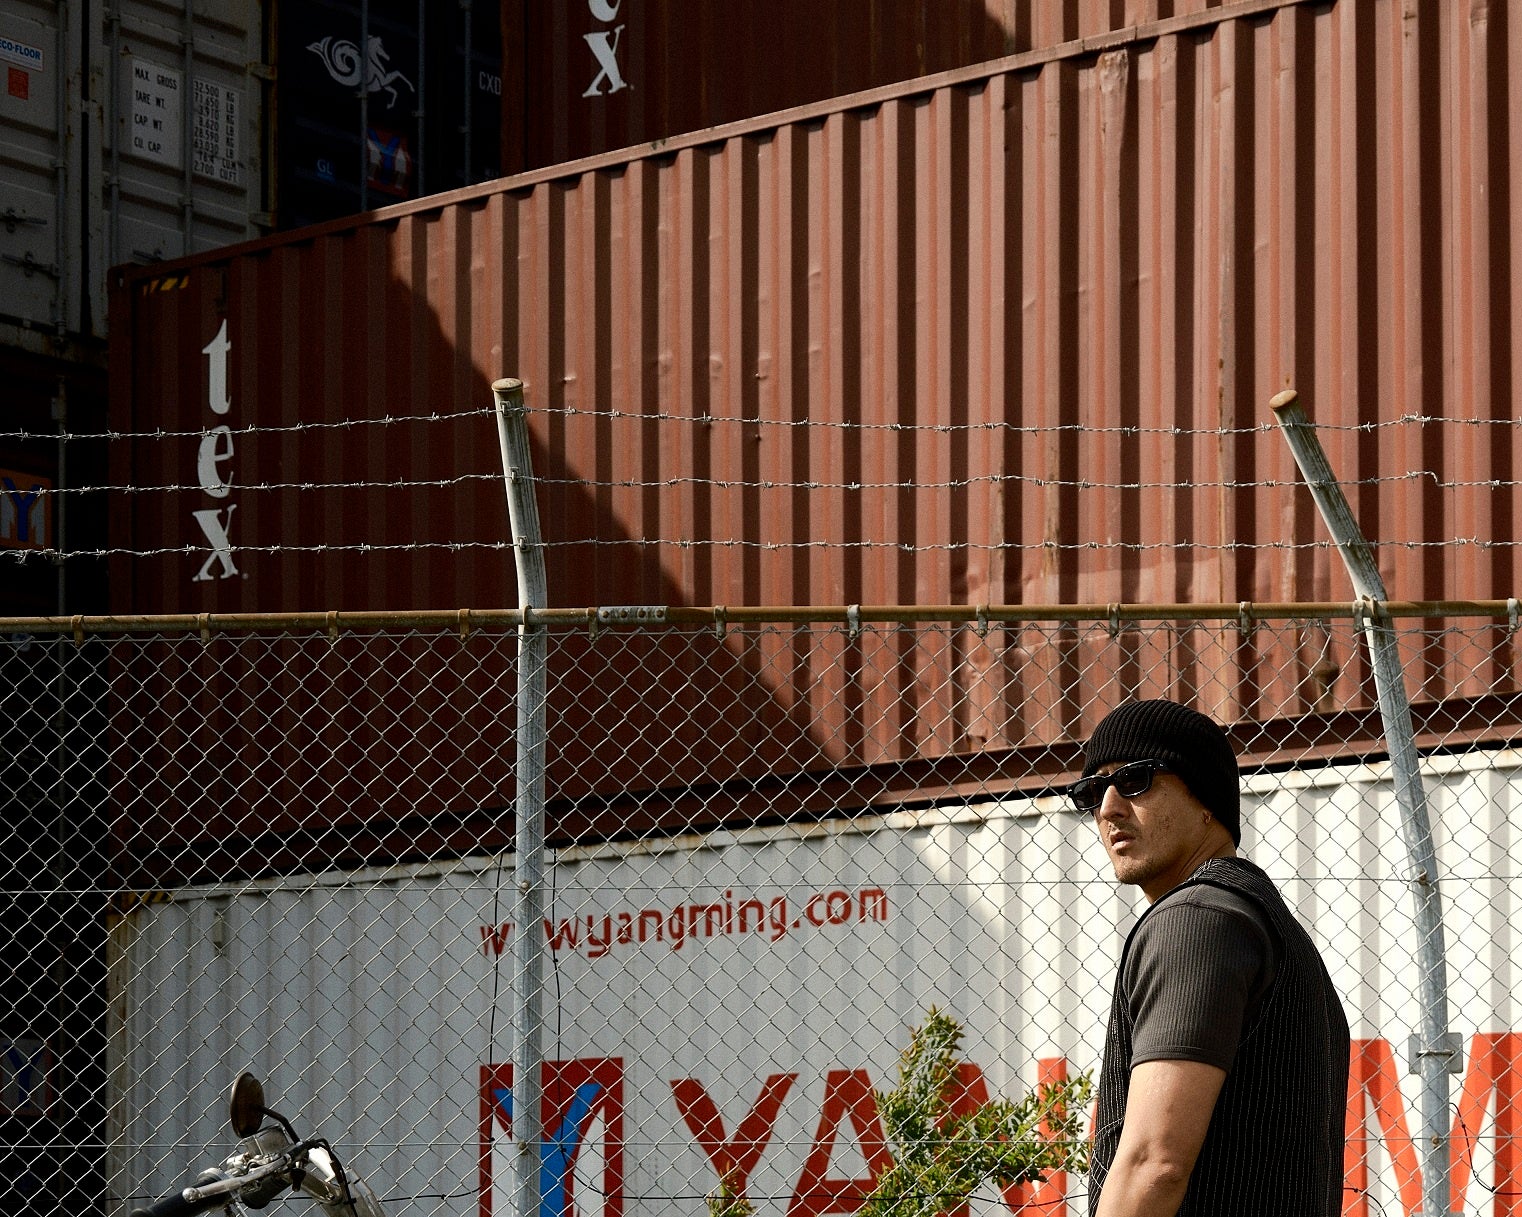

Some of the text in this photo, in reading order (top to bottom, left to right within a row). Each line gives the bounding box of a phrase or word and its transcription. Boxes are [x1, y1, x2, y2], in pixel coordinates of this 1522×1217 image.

[157, 74, 178, 90] GROSS
[135, 90, 151, 105] TARE
[480, 888, 888, 958] ww.yangming.com
